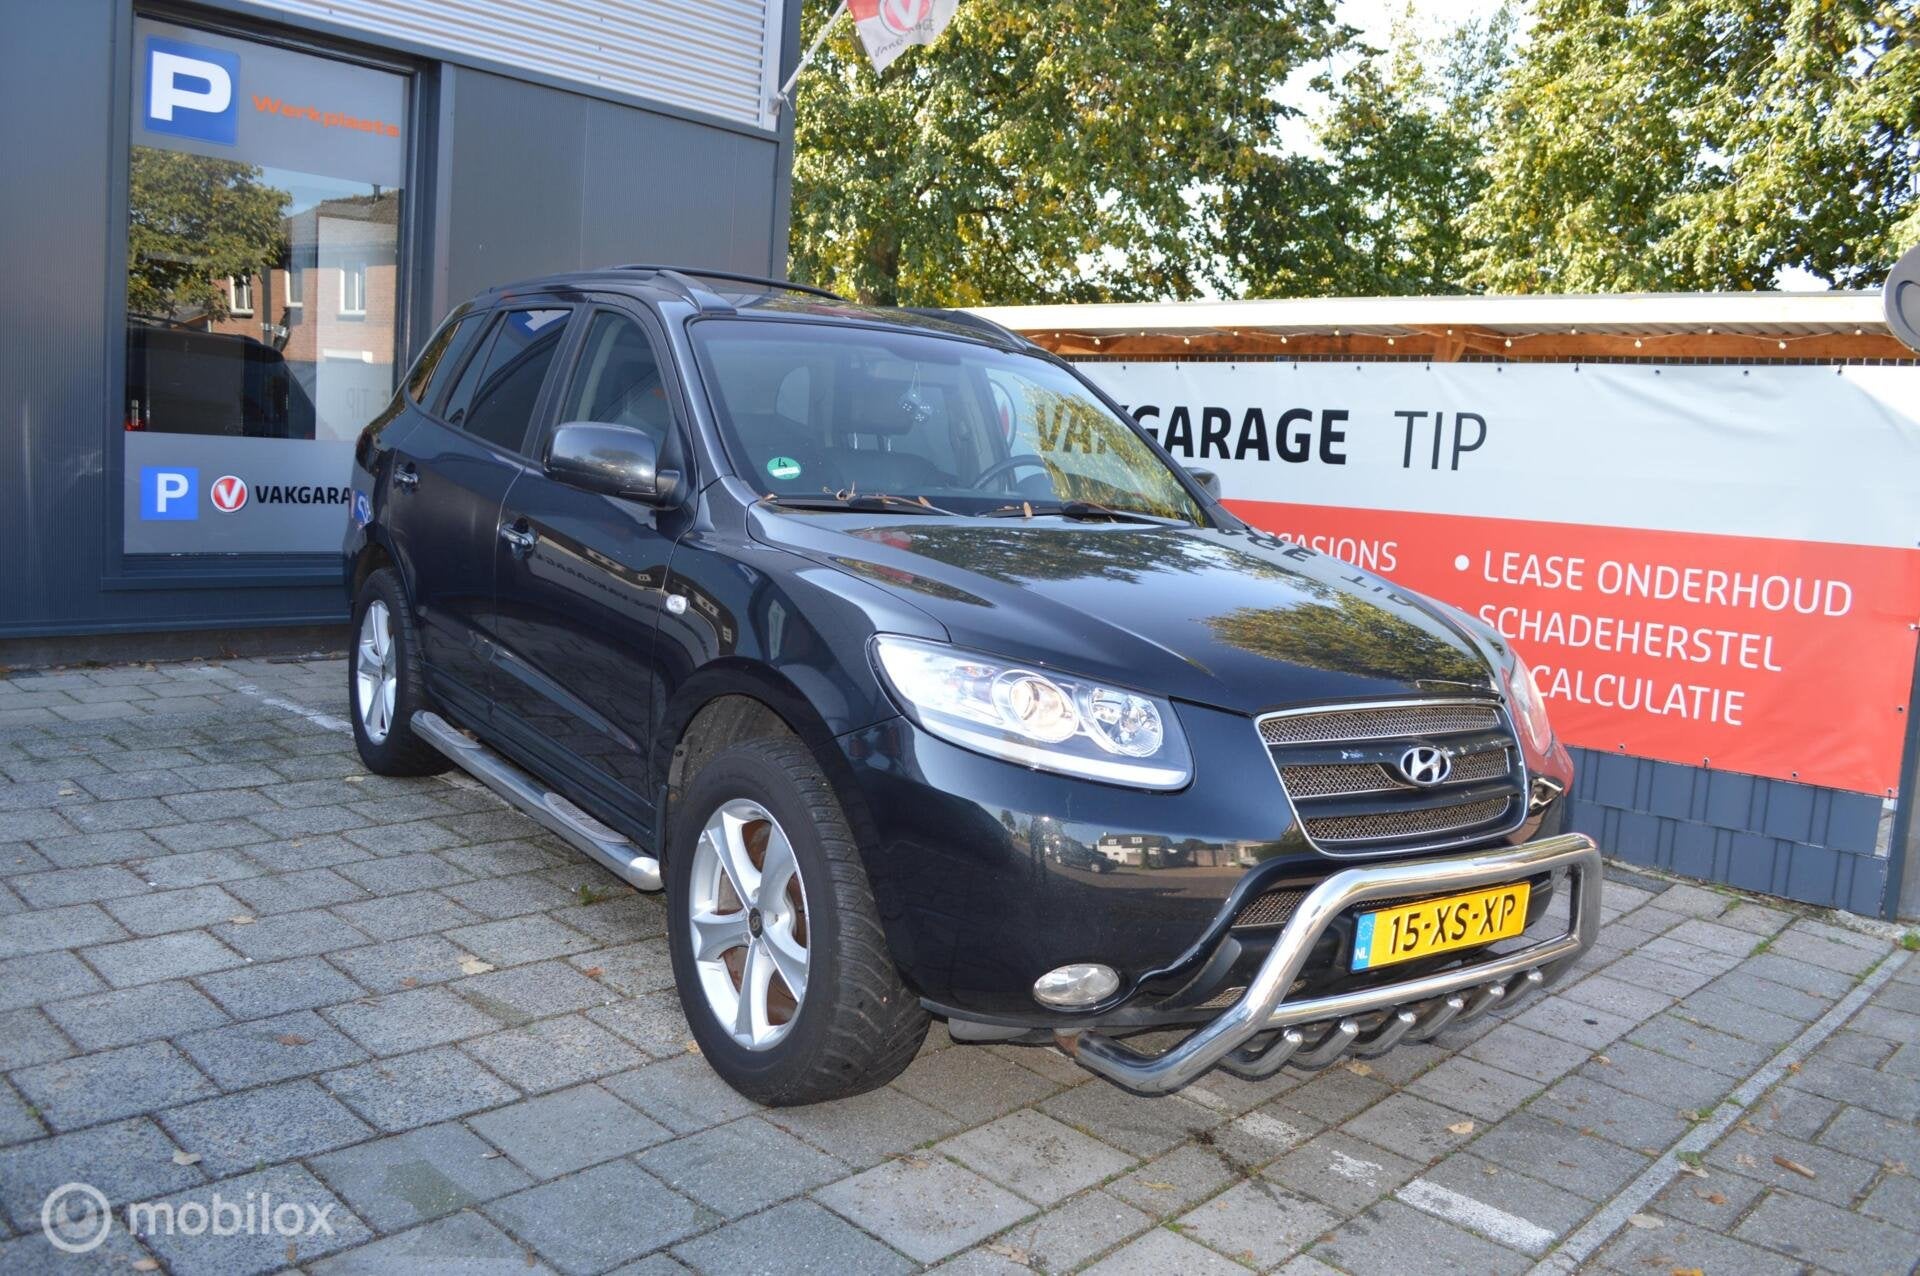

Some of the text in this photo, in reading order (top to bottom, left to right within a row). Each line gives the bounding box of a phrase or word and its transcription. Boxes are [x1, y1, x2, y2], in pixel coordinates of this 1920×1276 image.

[150, 51, 232, 121] P
[251, 95, 400, 138] Werkplaats
[1393, 410, 1488, 471] TIP
[156, 472, 189, 513] P
[1483, 550, 1852, 617] LEASE ONDERHOUD
[1478, 604, 1782, 673] SCHADEHERSTEL
[1530, 664, 1746, 726] CALCULATIE
[1355, 947, 1369, 960] NL
[1391, 893, 1517, 955] 15-XS-XP
